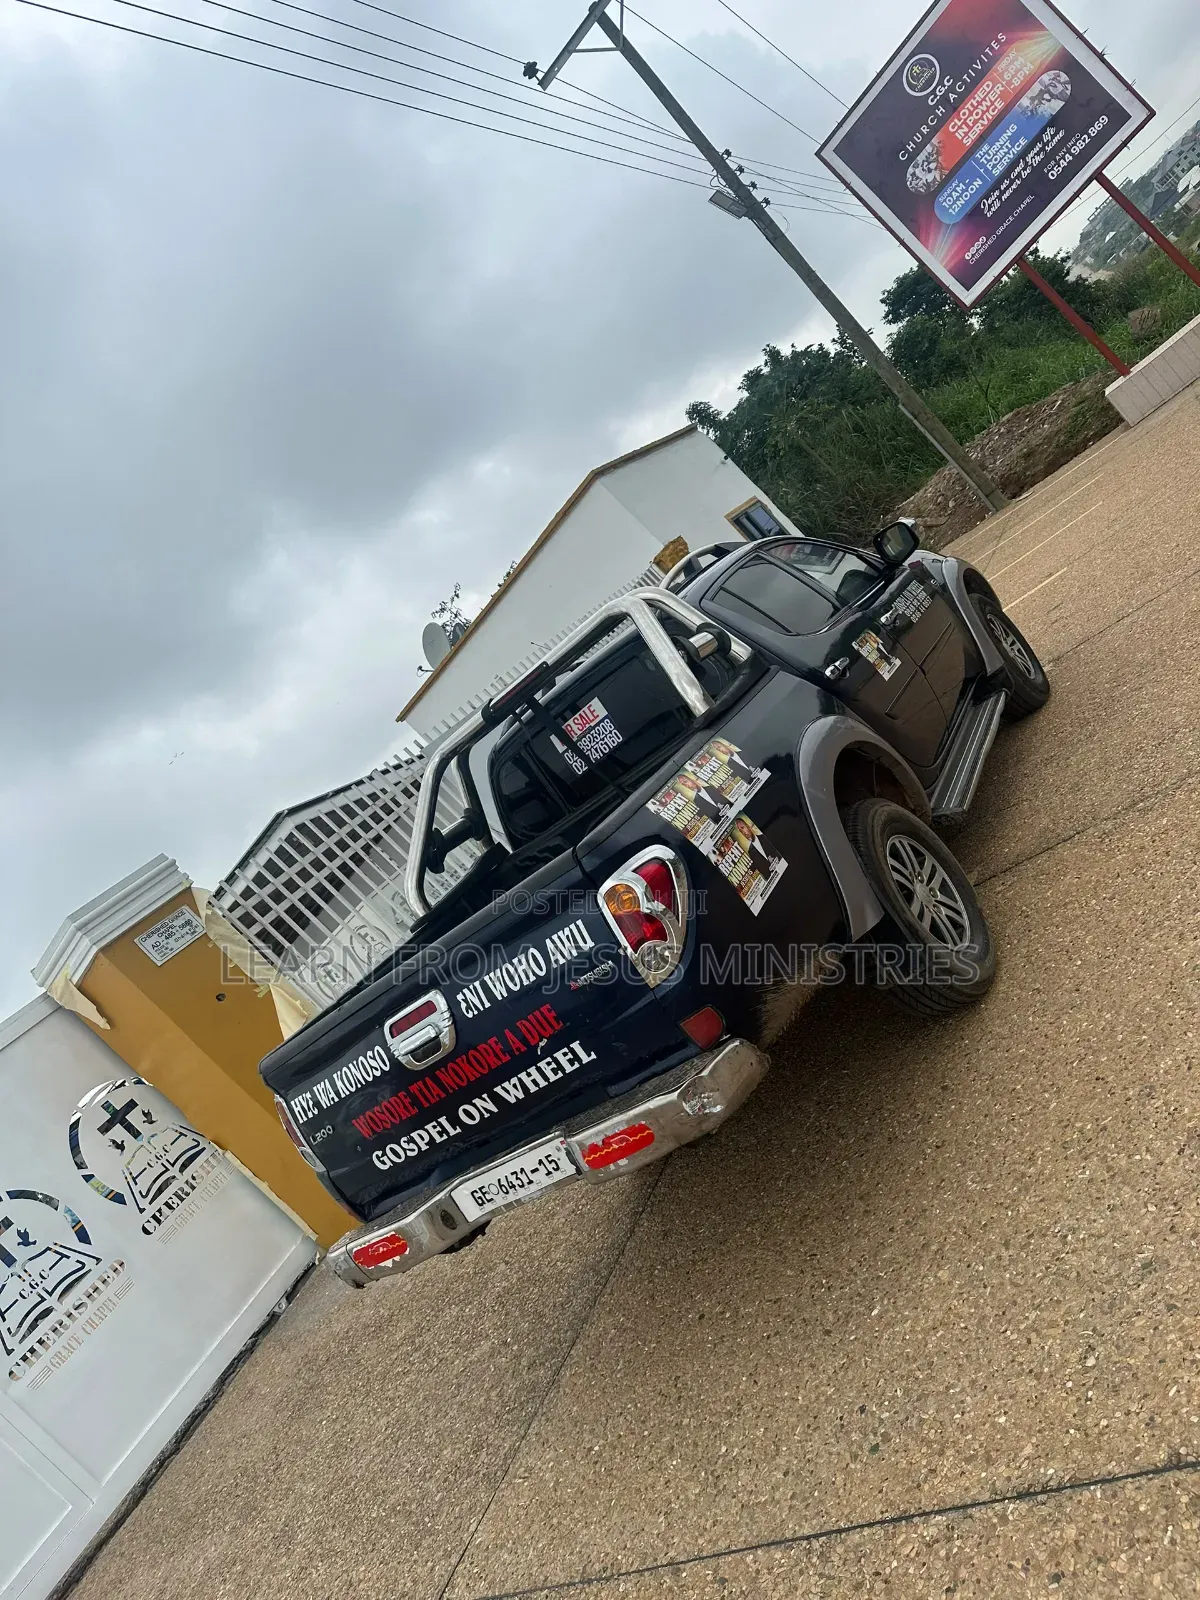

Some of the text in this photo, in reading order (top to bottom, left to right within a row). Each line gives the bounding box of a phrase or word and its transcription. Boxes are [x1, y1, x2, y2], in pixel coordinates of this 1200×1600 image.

[899, 33, 1006, 160] CHURCH ACTIVITES
[928, 76, 953, 105] C.G.C
[949, 81, 992, 132] CLOTHED
[956, 84, 1004, 139] IN POWER
[963, 98, 1004, 146] SERVICE
[975, 144, 990, 158] THE
[980, 124, 1017, 164] TURNING
[986, 140, 1011, 170] POINT
[992, 137, 1027, 176] SERVICE
[1044, 133, 1080, 173] FOR ANY INFO
[1048, 116, 1108, 179] 0544 982 869
[981, 127, 1055, 214] Join us and your life
[984, 130, 1064, 217] will never be the same
[939, 179, 958, 202] SUNDAY
[942, 183, 966, 208] 10AM
[949, 178, 982, 214] 12NOON
[970, 195, 1034, 264] CHERISHED GRACE CHAPEL
[573, 704, 599, 732] SALE
[696, 757, 723, 781] REPENT
[659, 793, 689, 822] REPENT
[671, 800, 700, 830] NOW!!!
[719, 841, 744, 876] REPENT
[152, 941, 161, 950] AD
[157, 924, 177, 937] CHAPEL
[313, 1079, 339, 1109] WA
[333, 1045, 390, 1098] KONOSO
[484, 948, 547, 1000] WOHO
[545, 919, 595, 968] AWU
[351, 1004, 563, 1139] WOSORE TIA NOKORE A DUE
[372, 1041, 597, 1170] GOSPEL ON WHEEL
[310, 1125, 334, 1145] L200
[147, 1144, 172, 1168] C.G.C
[19, 1269, 49, 1300] C.G.C
[8, 1259, 126, 1381] CHERISHED
[49, 1297, 119, 1369] GRACE CHAPEL
